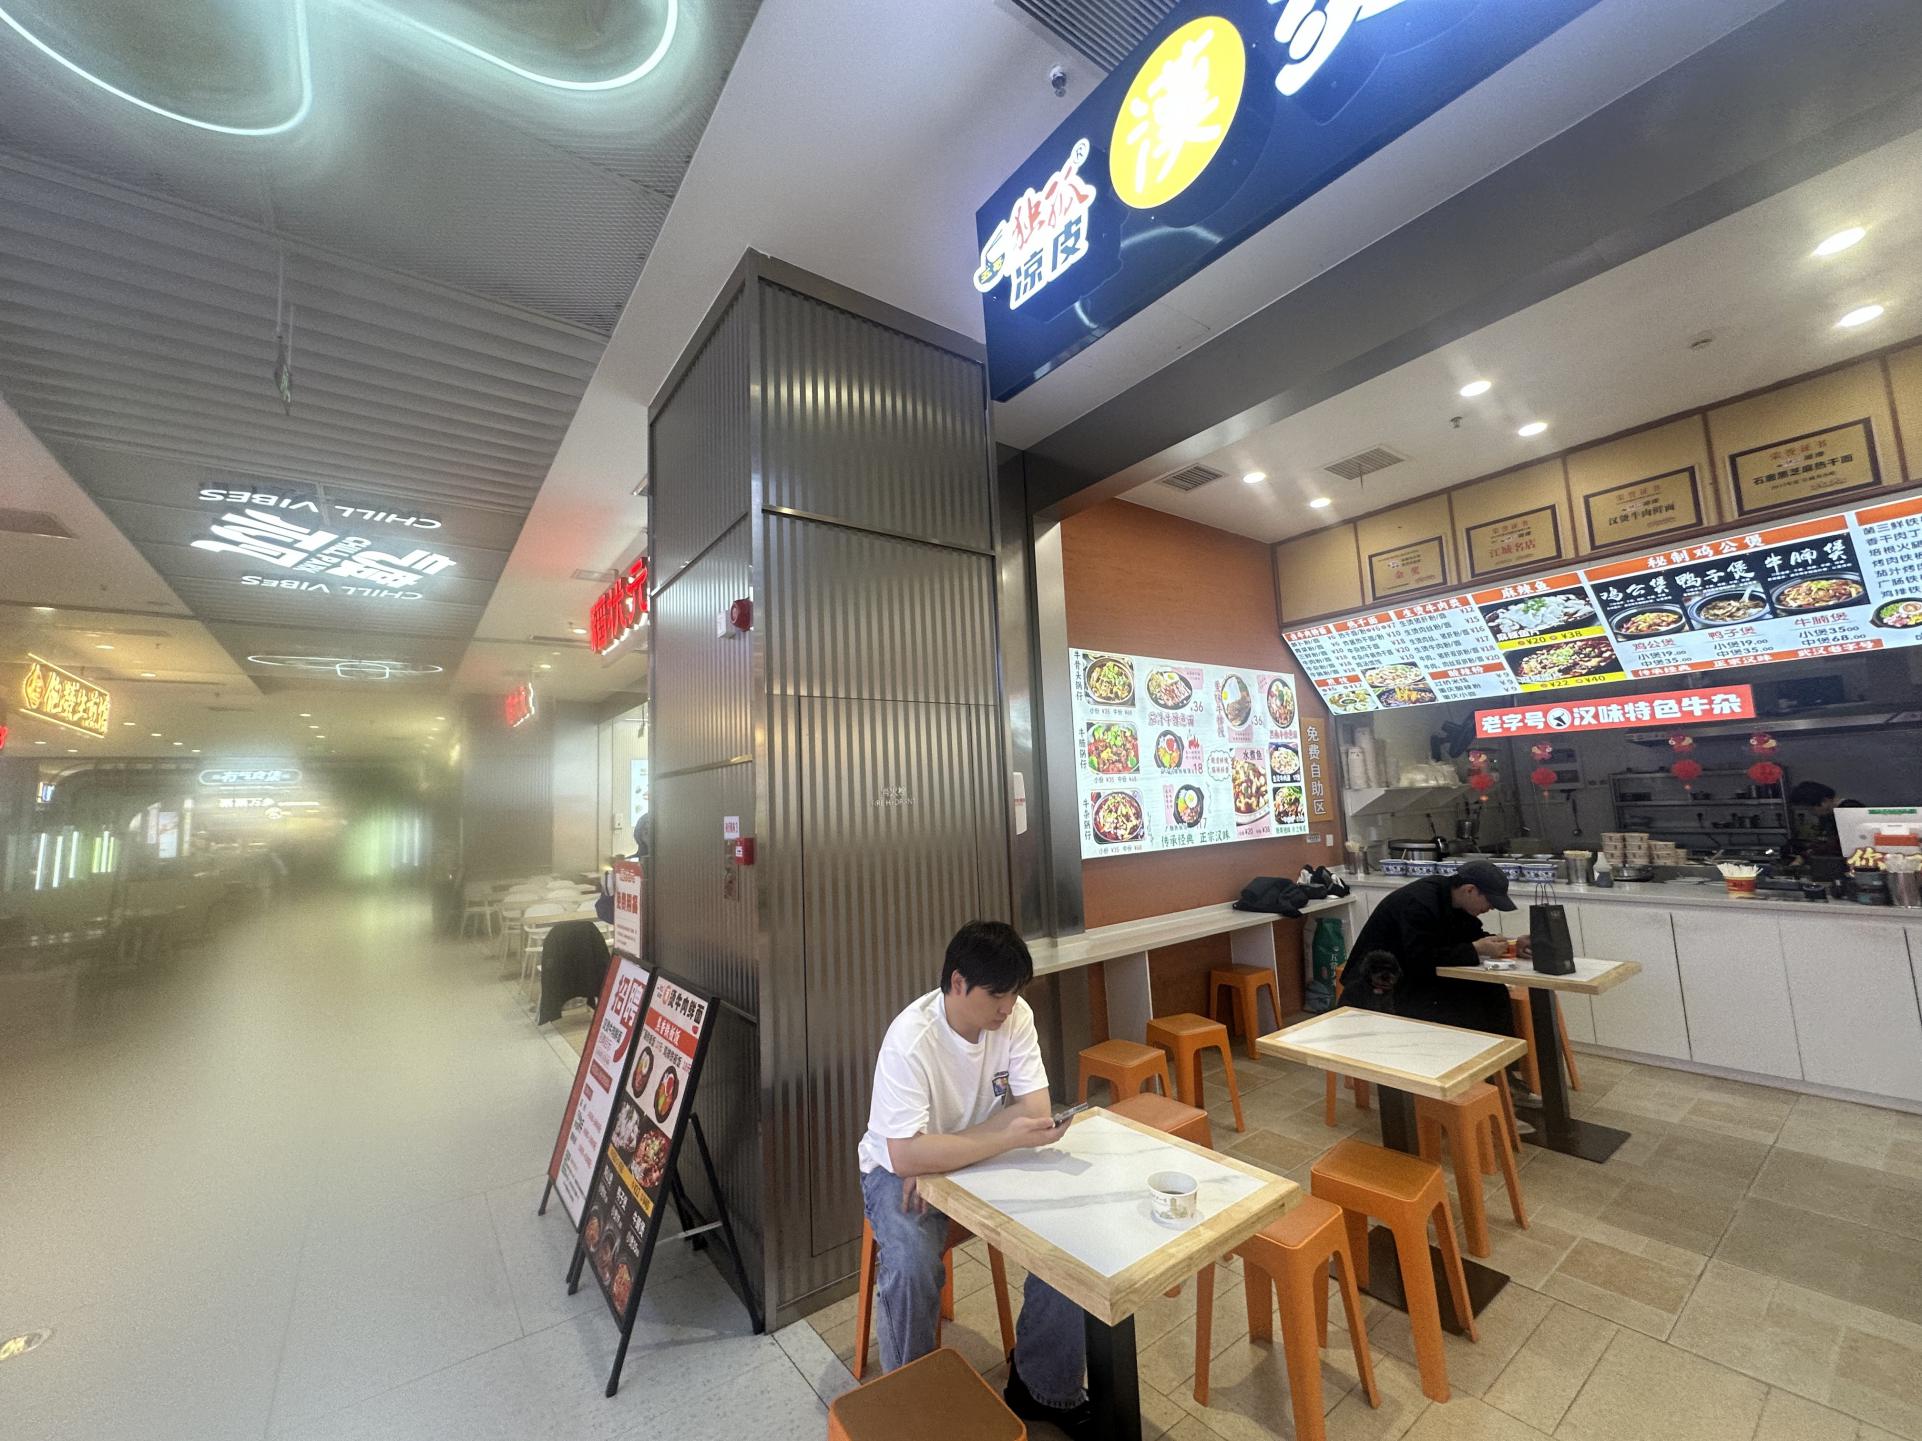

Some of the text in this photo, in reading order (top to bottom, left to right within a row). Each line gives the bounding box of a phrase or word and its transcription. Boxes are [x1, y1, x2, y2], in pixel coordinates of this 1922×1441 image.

[199, 489, 442, 529] CHILL VIBES
[1863, 516, 1922, 535] 菌三鲜铁
[292, 535, 373, 575] CHILL PARK
[1647, 534, 1765, 568] 秘制鸡公煲
[1600, 576, 1670, 602] 鸡公煲
[1674, 560, 1754, 588] 鸭子煲
[1764, 539, 1848, 573] 牛腩煲
[1878, 574, 1922, 589] 广肠铁
[241, 575, 423, 600] CHILL VIBES
[1500, 580, 1552, 599] 麻辣鱼
[1526, 630, 1583, 644] ¥20 ¥38
[1708, 626, 1757, 640] 鸭子煲
[1795, 612, 1848, 627] 牛腩煲
[1482, 693, 1742, 734] 老字号 汉味特色牛杂
[1242, 750, 1263, 761] 水煮鱼
[1306, 726, 1326, 815] 免费自助区
[1162, 834, 1195, 848] 传承经典
[1200, 830, 1231, 844] 正宗汉味
[610, 974, 647, 1028] 招聘
